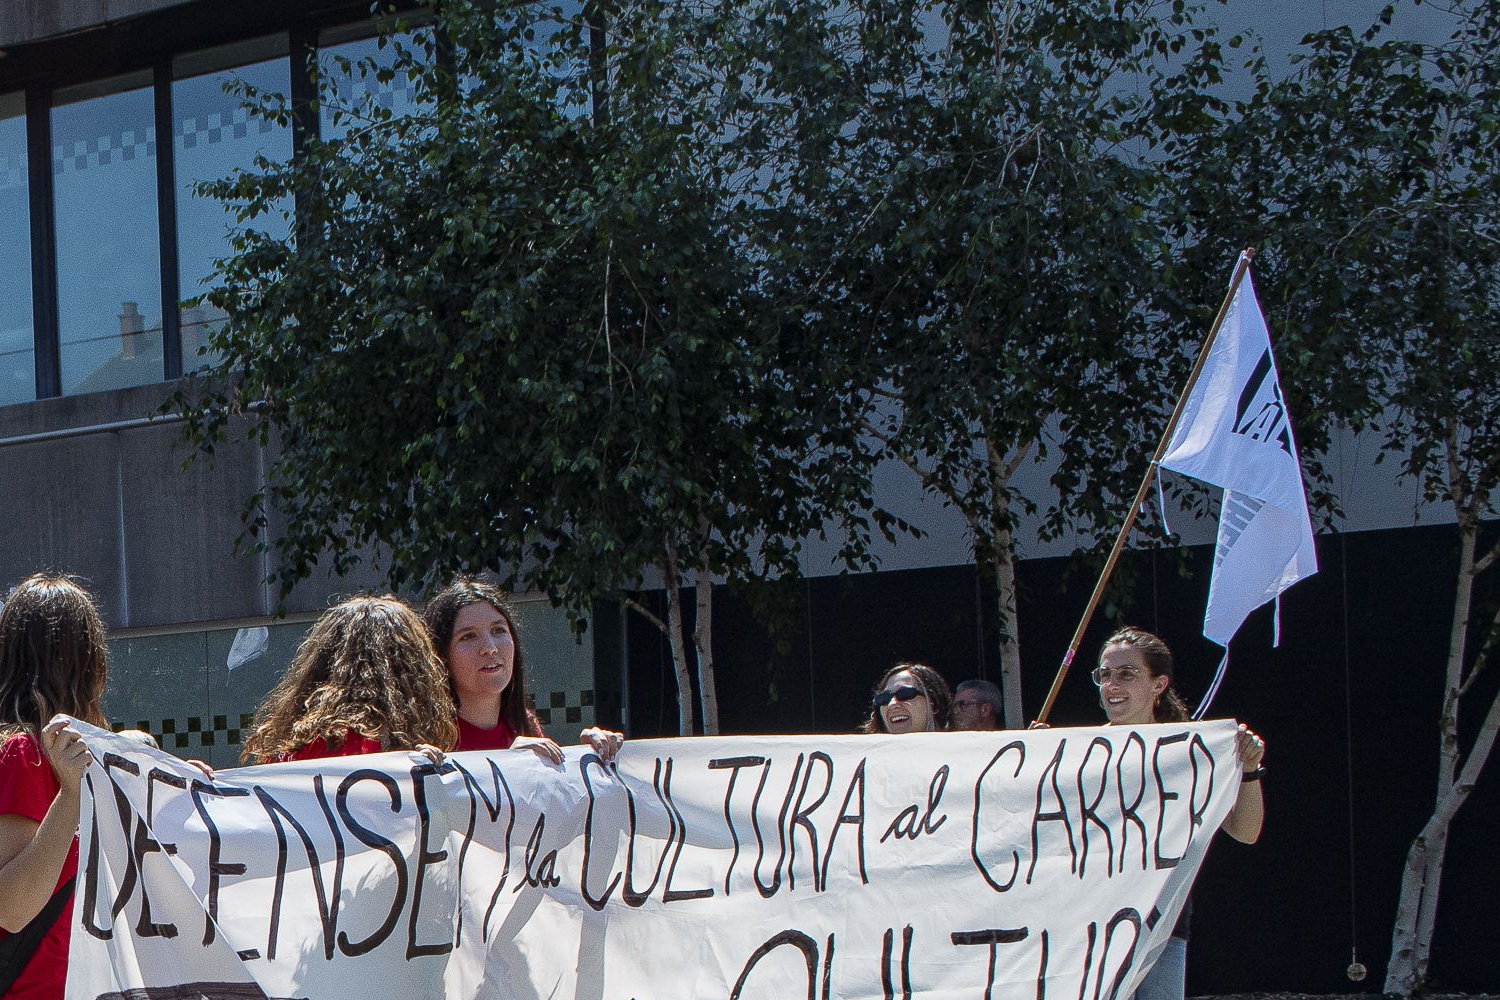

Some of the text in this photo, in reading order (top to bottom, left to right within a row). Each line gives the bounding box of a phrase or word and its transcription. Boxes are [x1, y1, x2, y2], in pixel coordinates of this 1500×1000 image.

[513, 813, 561, 894] la
[580, 752, 868, 911] CULTURA
[880, 765, 948, 844] al
